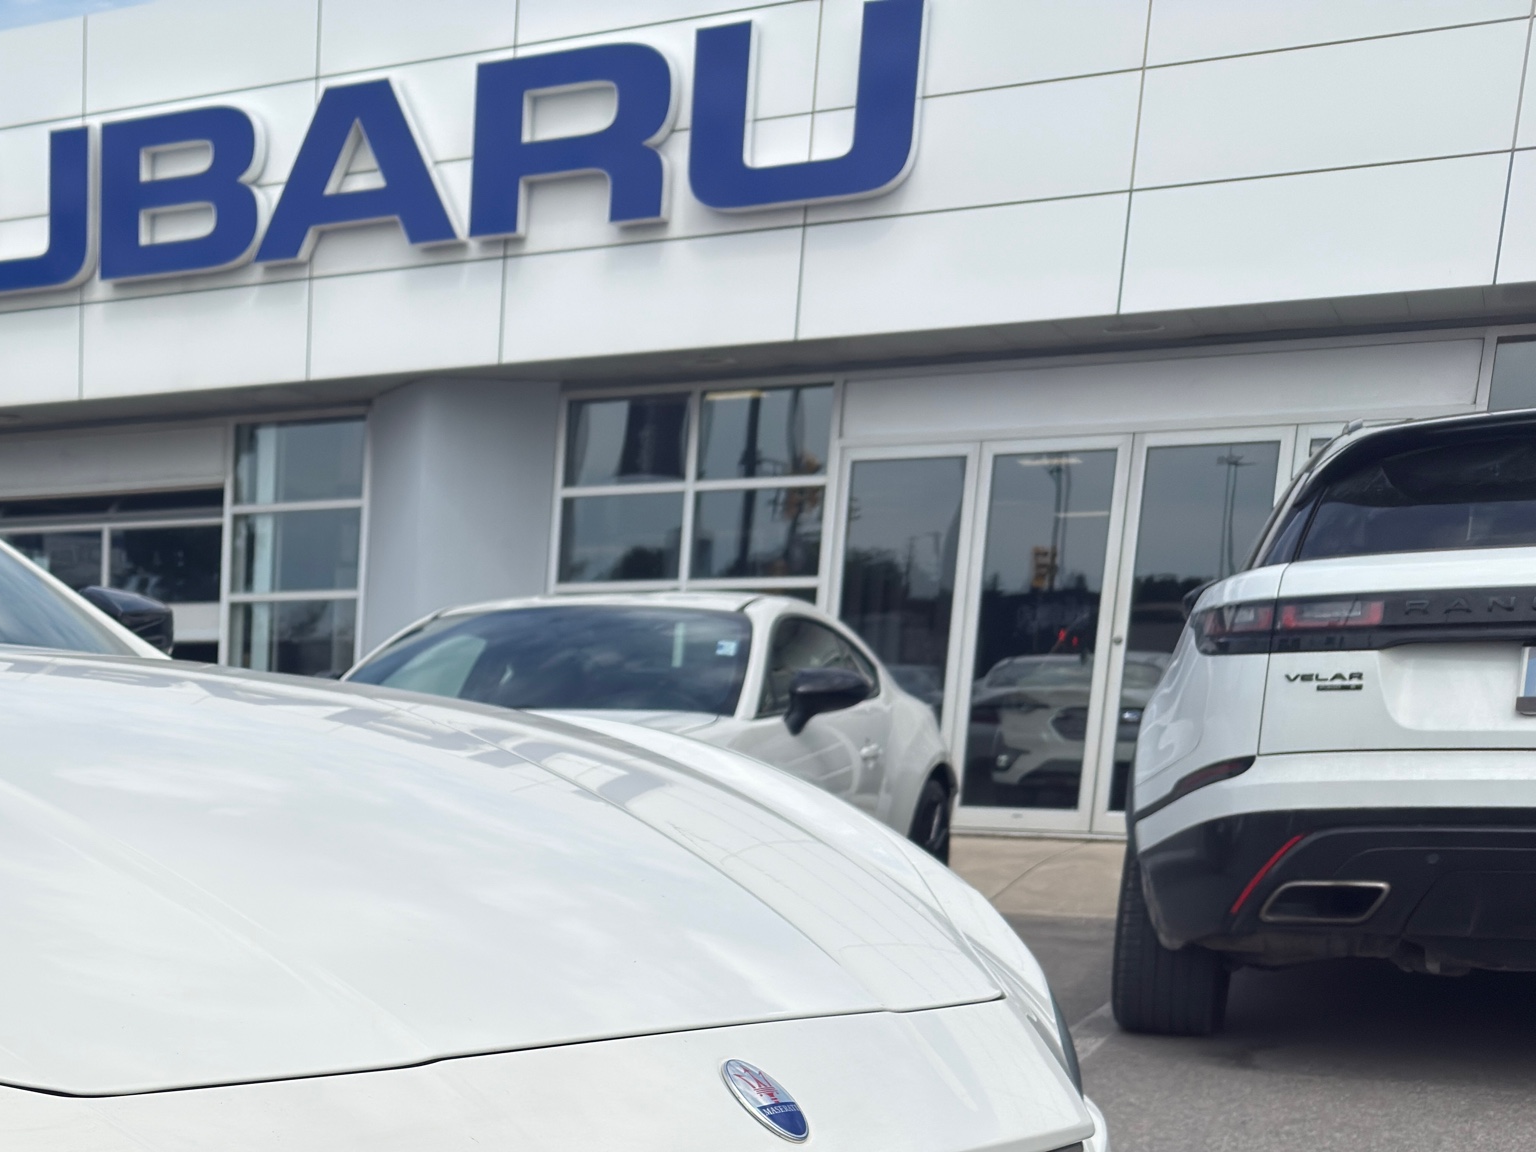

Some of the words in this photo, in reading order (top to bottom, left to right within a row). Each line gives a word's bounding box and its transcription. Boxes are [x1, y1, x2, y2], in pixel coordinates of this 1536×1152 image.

[1405, 596, 1536, 616] RAN
[1285, 672, 1363, 682] VELAR
[762, 1104, 800, 1116] MASERATI
